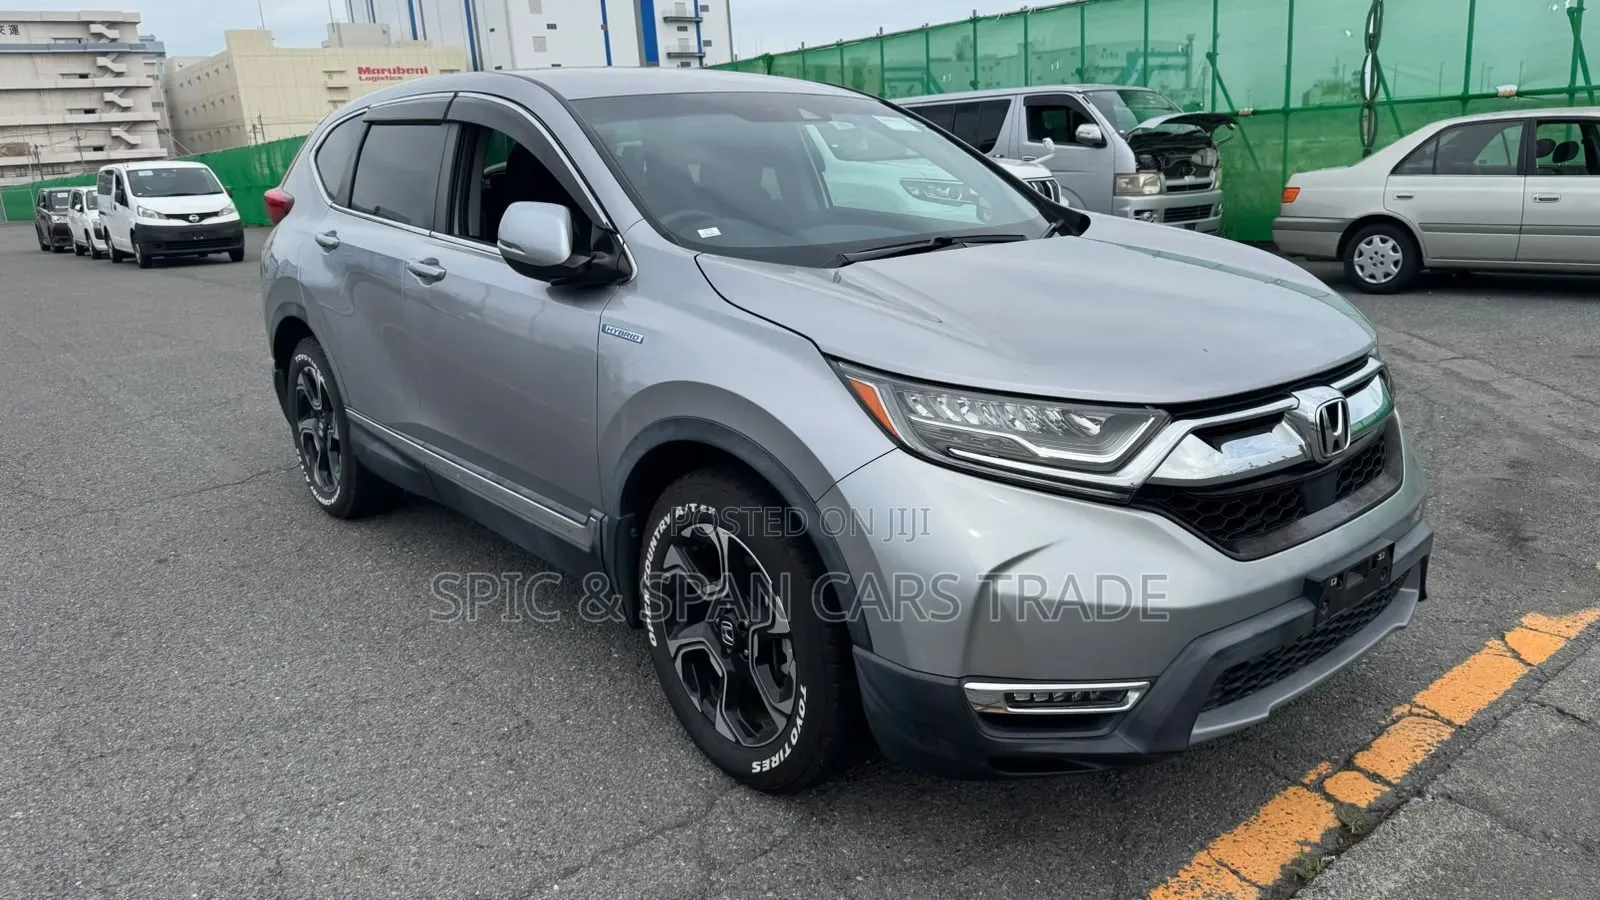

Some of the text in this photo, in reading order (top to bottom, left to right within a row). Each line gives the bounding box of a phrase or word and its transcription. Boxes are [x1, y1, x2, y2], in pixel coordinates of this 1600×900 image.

[357, 66, 428, 75] Marubeni
[606, 326, 640, 341] HYBRID
[643, 513, 671, 586] COUNTRY
[751, 684, 807, 773] TOYO TIRES
